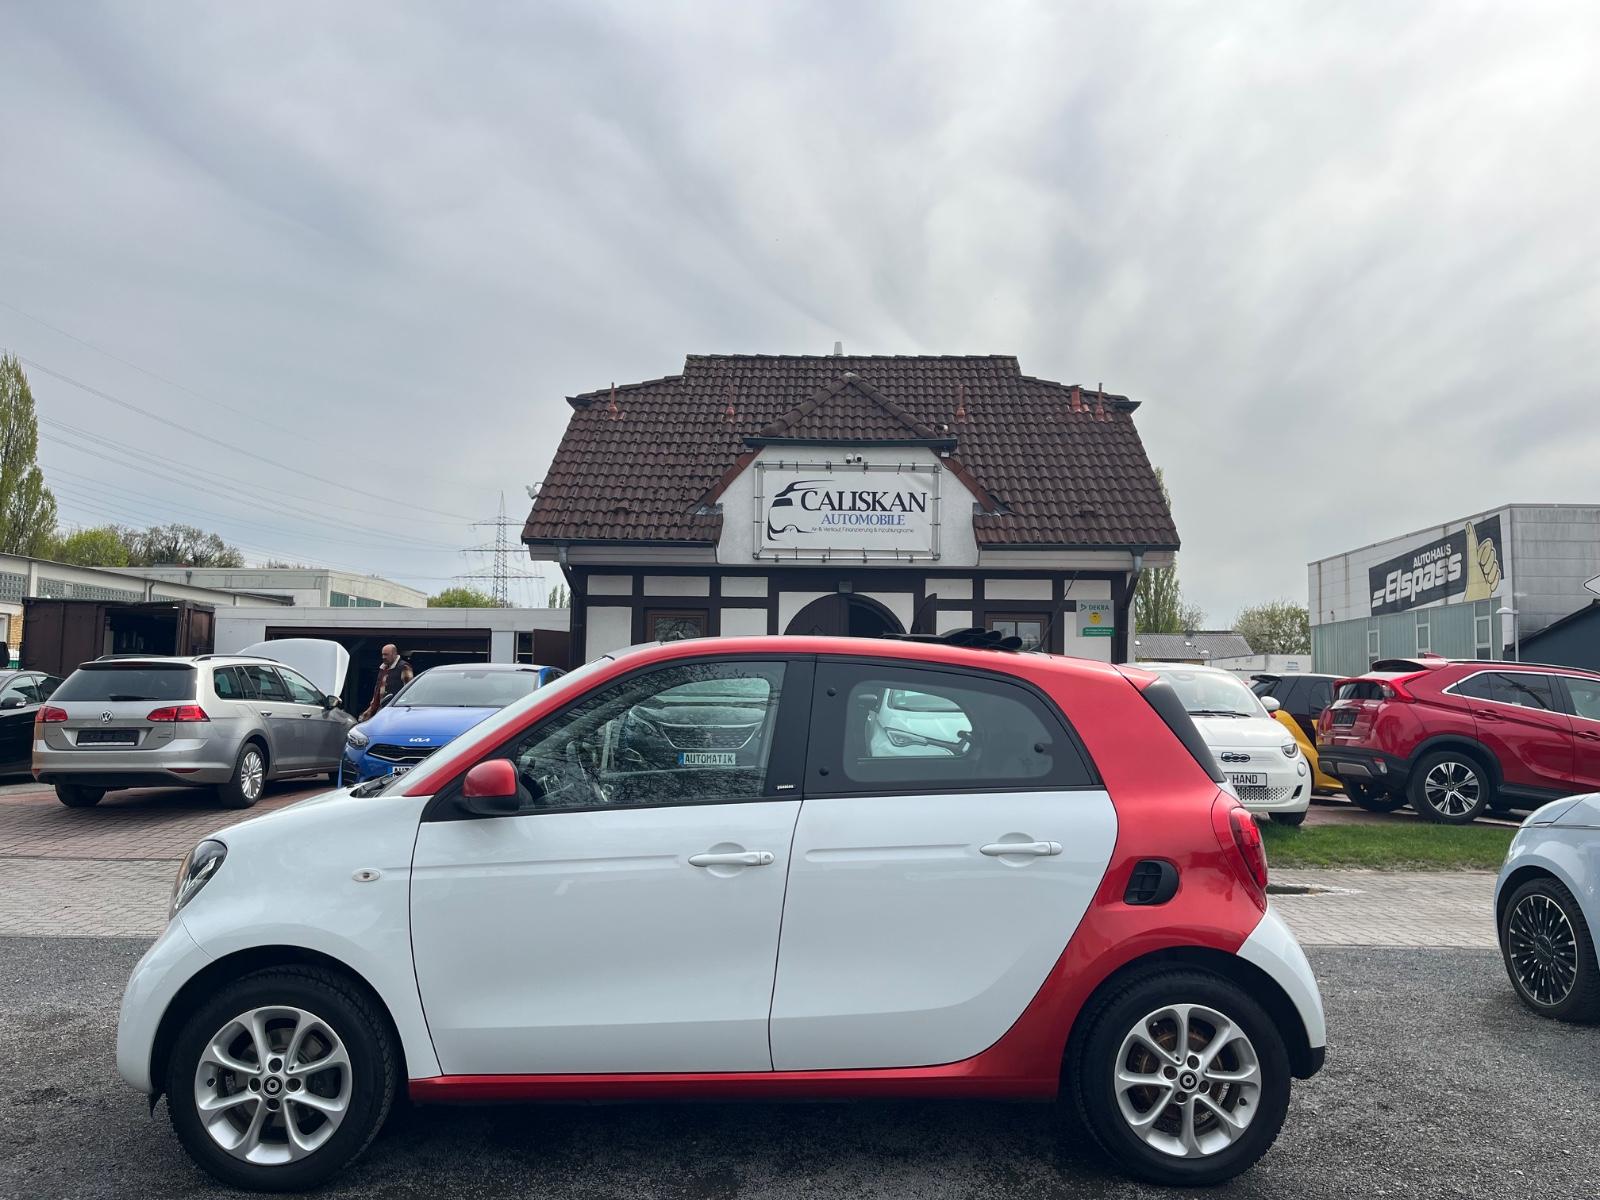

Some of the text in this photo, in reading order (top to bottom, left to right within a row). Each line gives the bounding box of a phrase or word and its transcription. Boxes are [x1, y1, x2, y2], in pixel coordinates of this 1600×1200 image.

[801, 490, 927, 513] CALISKAN
[821, 513, 905, 526] AUTOMOBILE
[1413, 543, 1452, 568] AUTOHAUS
[1385, 552, 1462, 603] Elspass
[685, 754, 733, 764] AUTOMATIK
[1232, 774, 1258, 784] HAND
